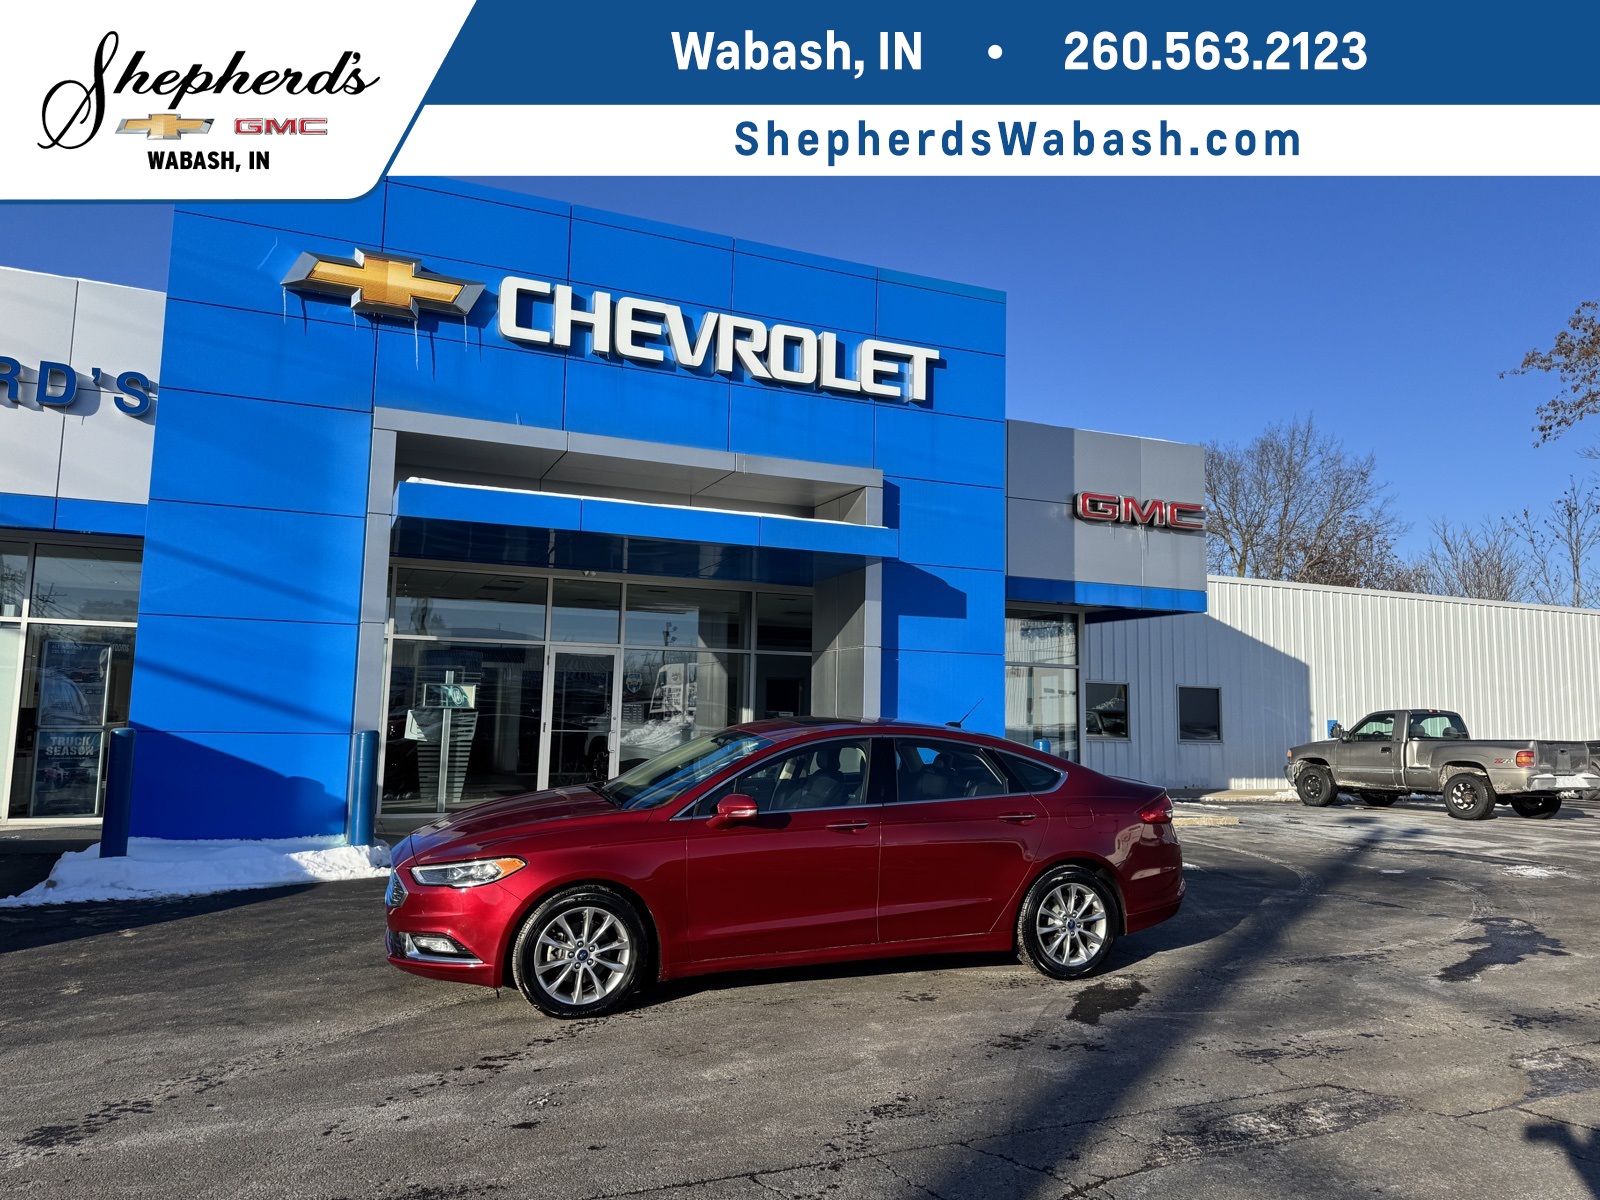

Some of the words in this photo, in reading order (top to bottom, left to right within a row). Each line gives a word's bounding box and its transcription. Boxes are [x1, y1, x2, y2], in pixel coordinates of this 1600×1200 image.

[499, 275, 940, 402] CHEVROLET
[1075, 491, 1204, 530] GMC
[45, 746, 93, 756] SEASON
[50, 736, 90, 747] TRUCK
